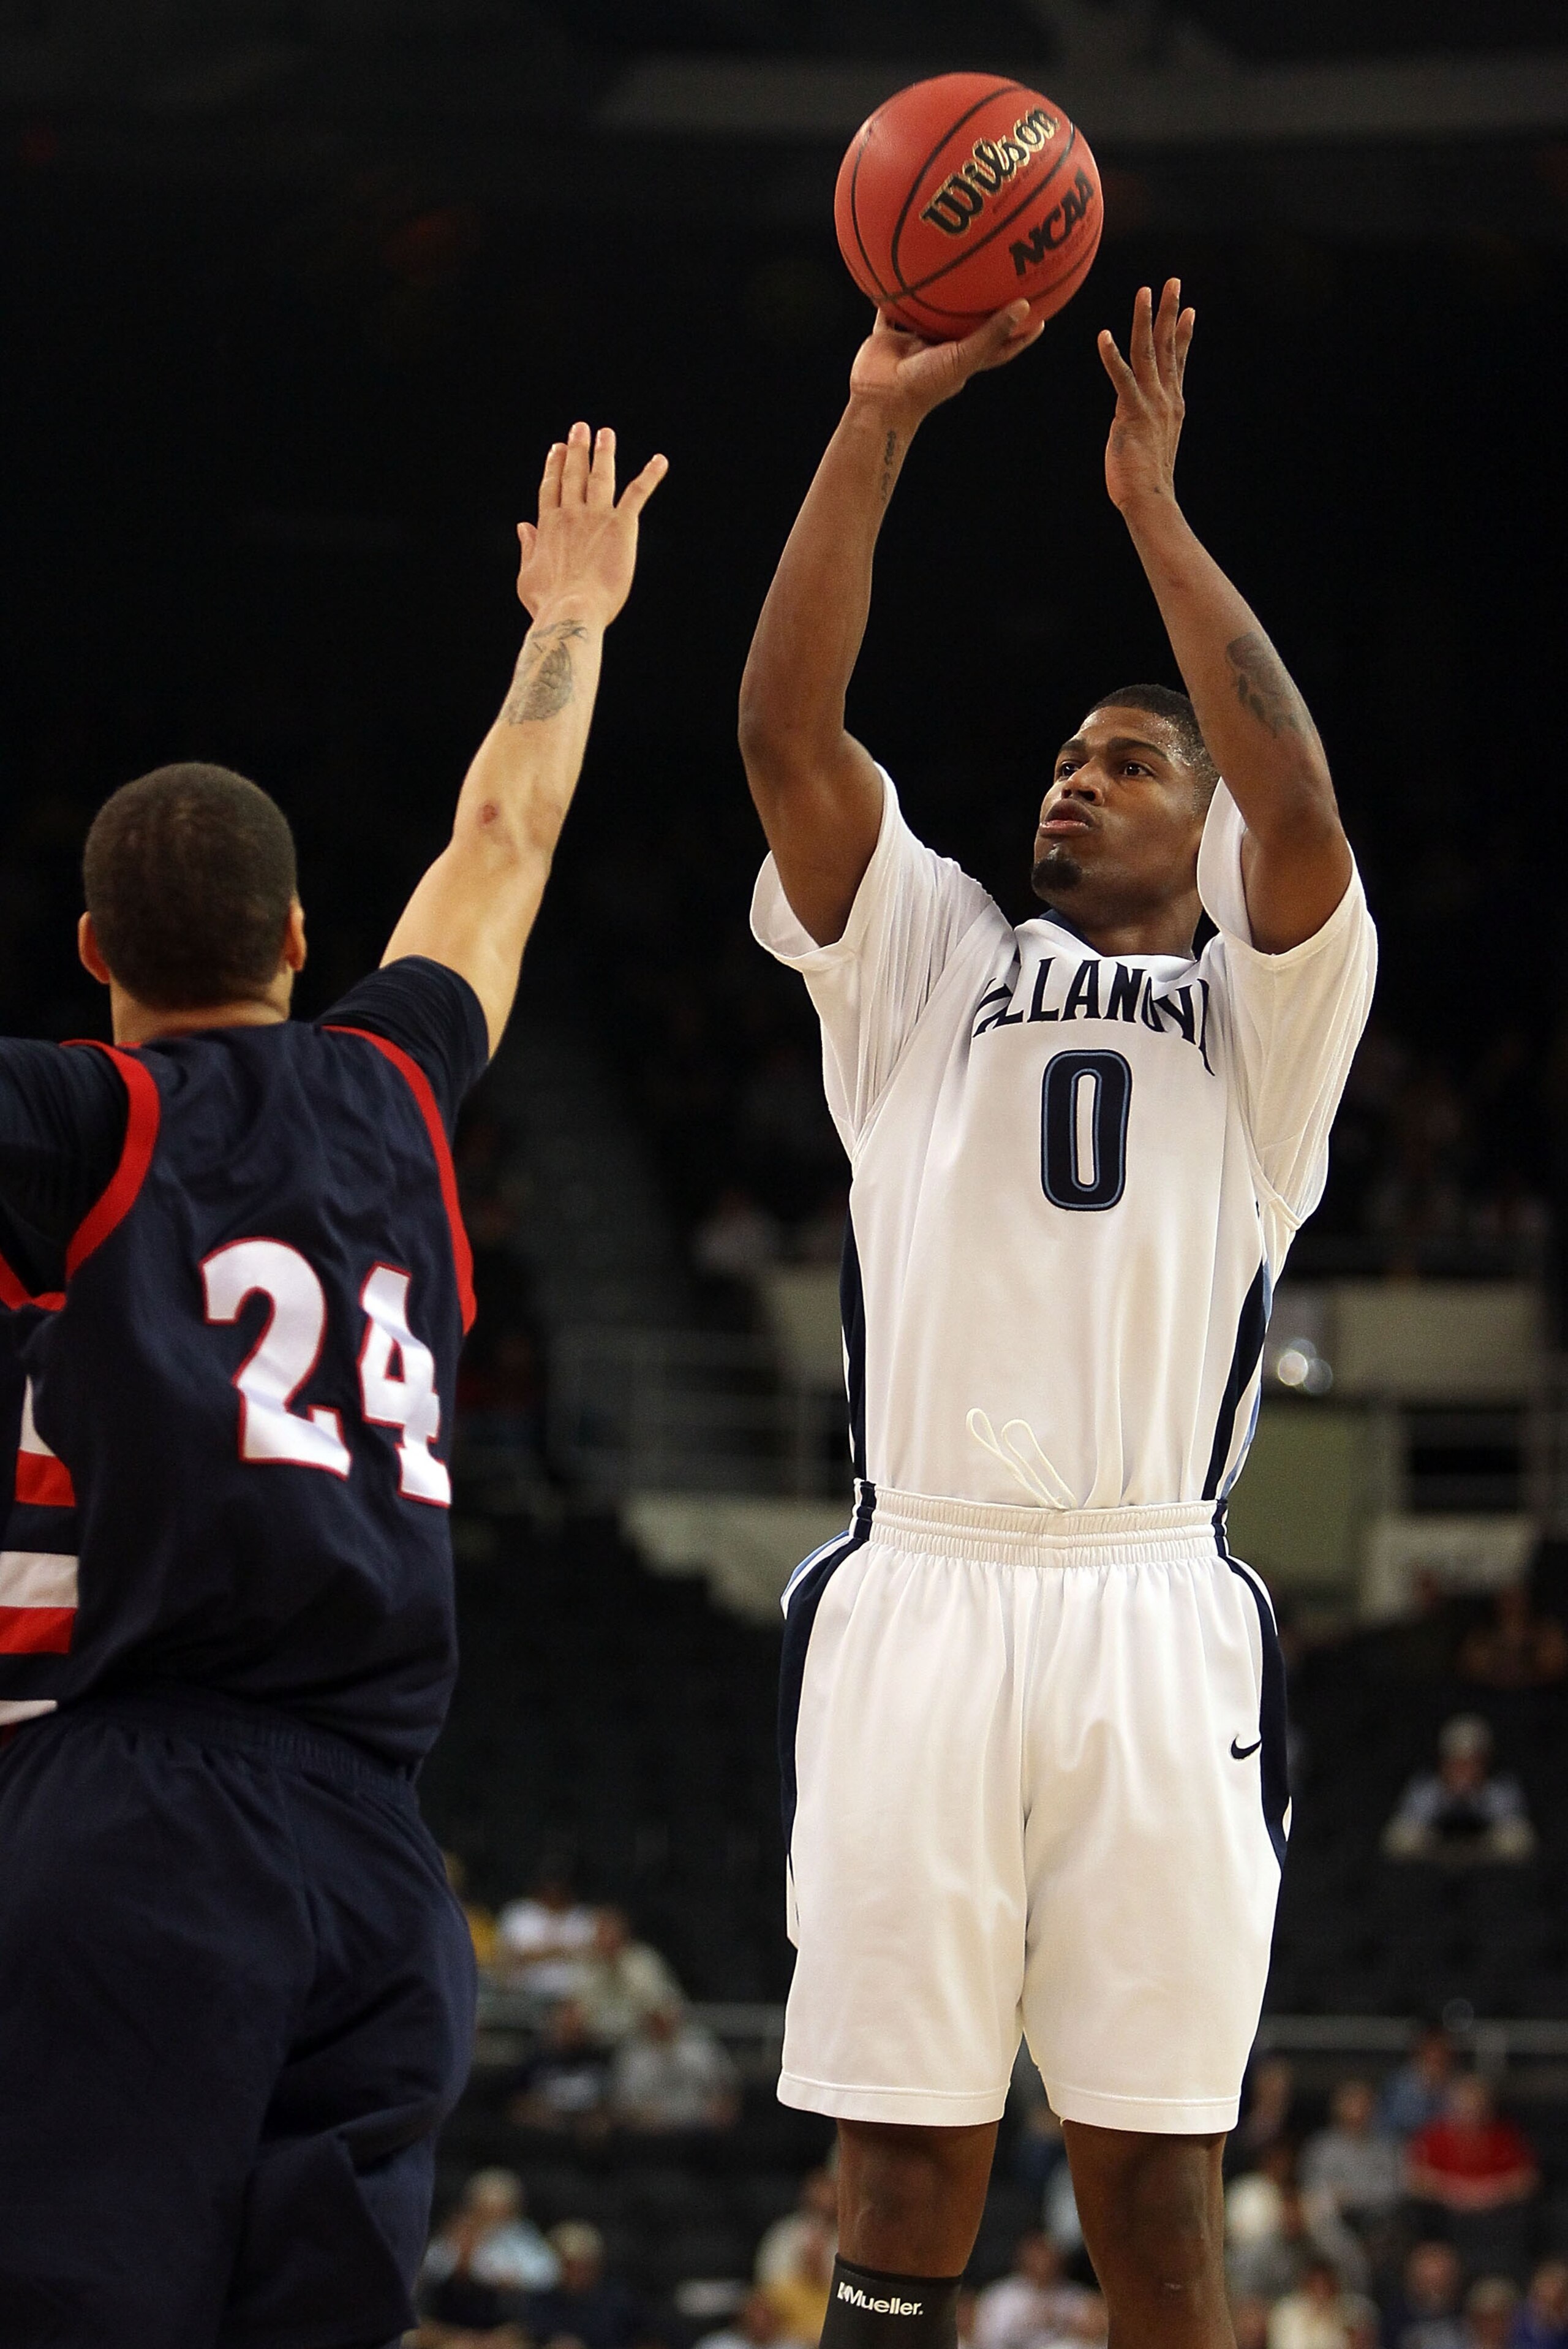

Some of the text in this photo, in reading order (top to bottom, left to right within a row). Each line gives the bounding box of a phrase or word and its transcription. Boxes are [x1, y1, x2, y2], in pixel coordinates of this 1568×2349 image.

[920, 104, 1060, 238] Wilson
[1008, 167, 1095, 276] NCAA
[1041, 1049, 1133, 1212] 0
[198, 1236, 452, 1508] 24
